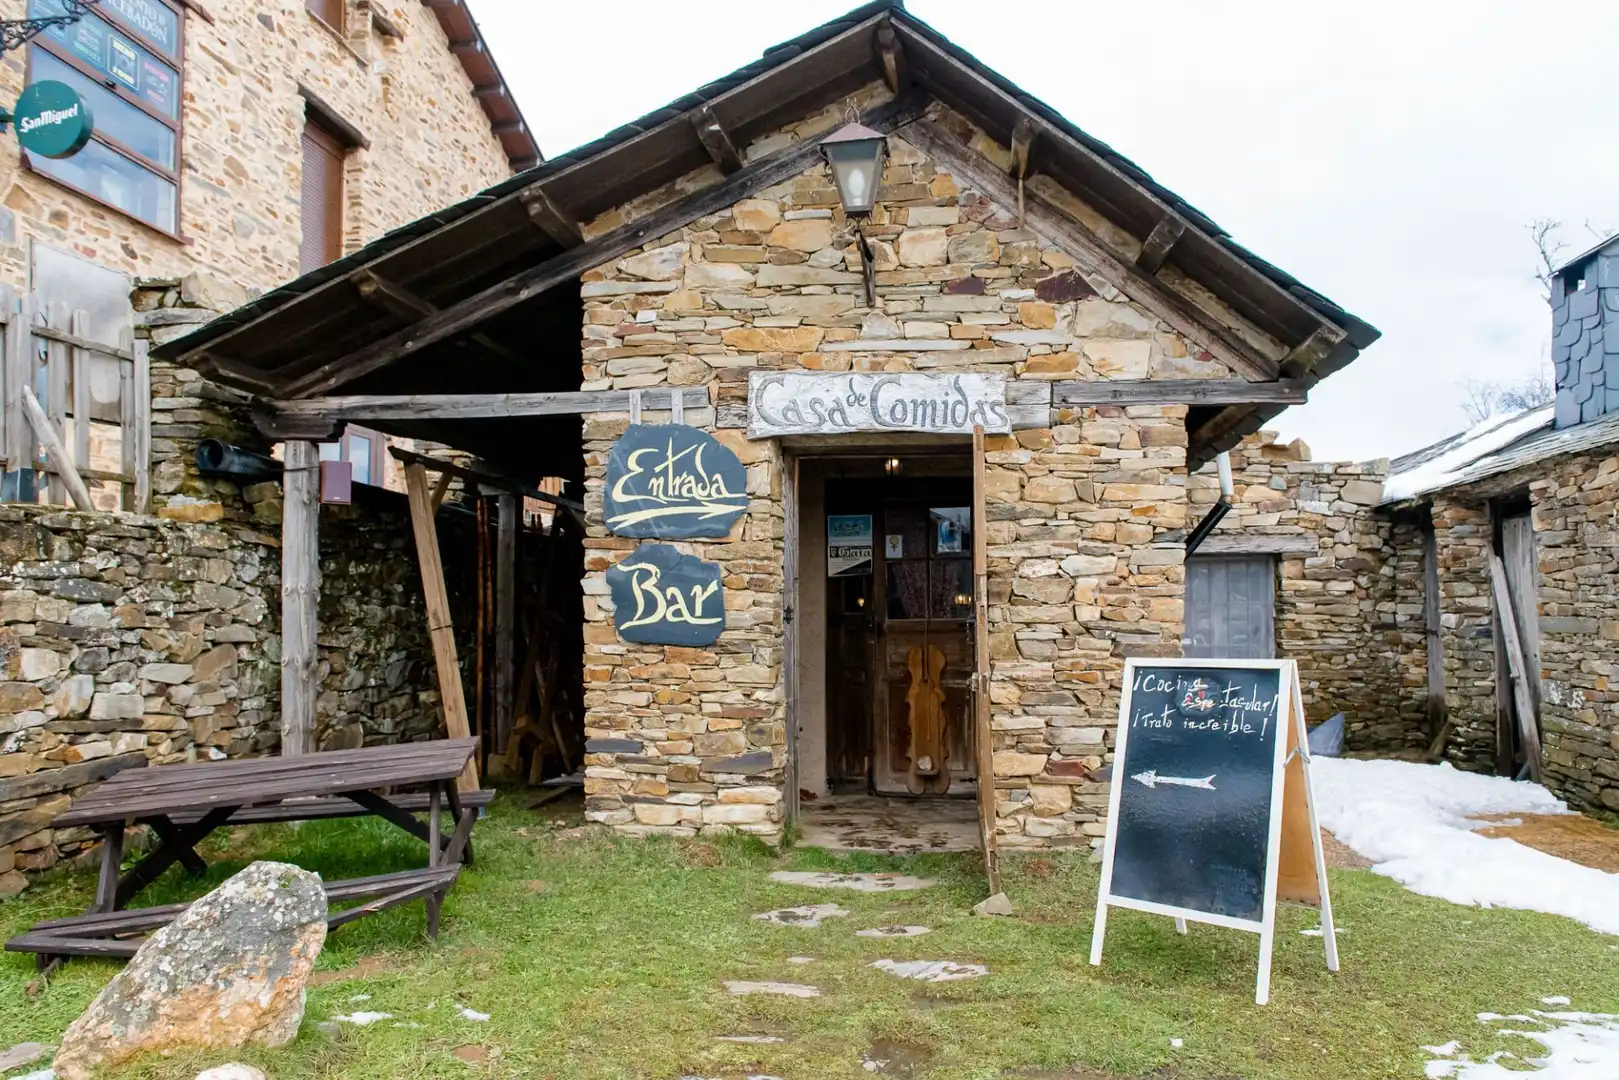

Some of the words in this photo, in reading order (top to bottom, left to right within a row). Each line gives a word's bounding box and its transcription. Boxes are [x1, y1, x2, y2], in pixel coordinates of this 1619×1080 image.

[755, 377, 849, 427] Casa
[846, 377, 866, 407] de
[870, 375, 1008, 428] Comidas
[612, 437, 748, 504] Entrada
[616, 562, 723, 630] Bar
